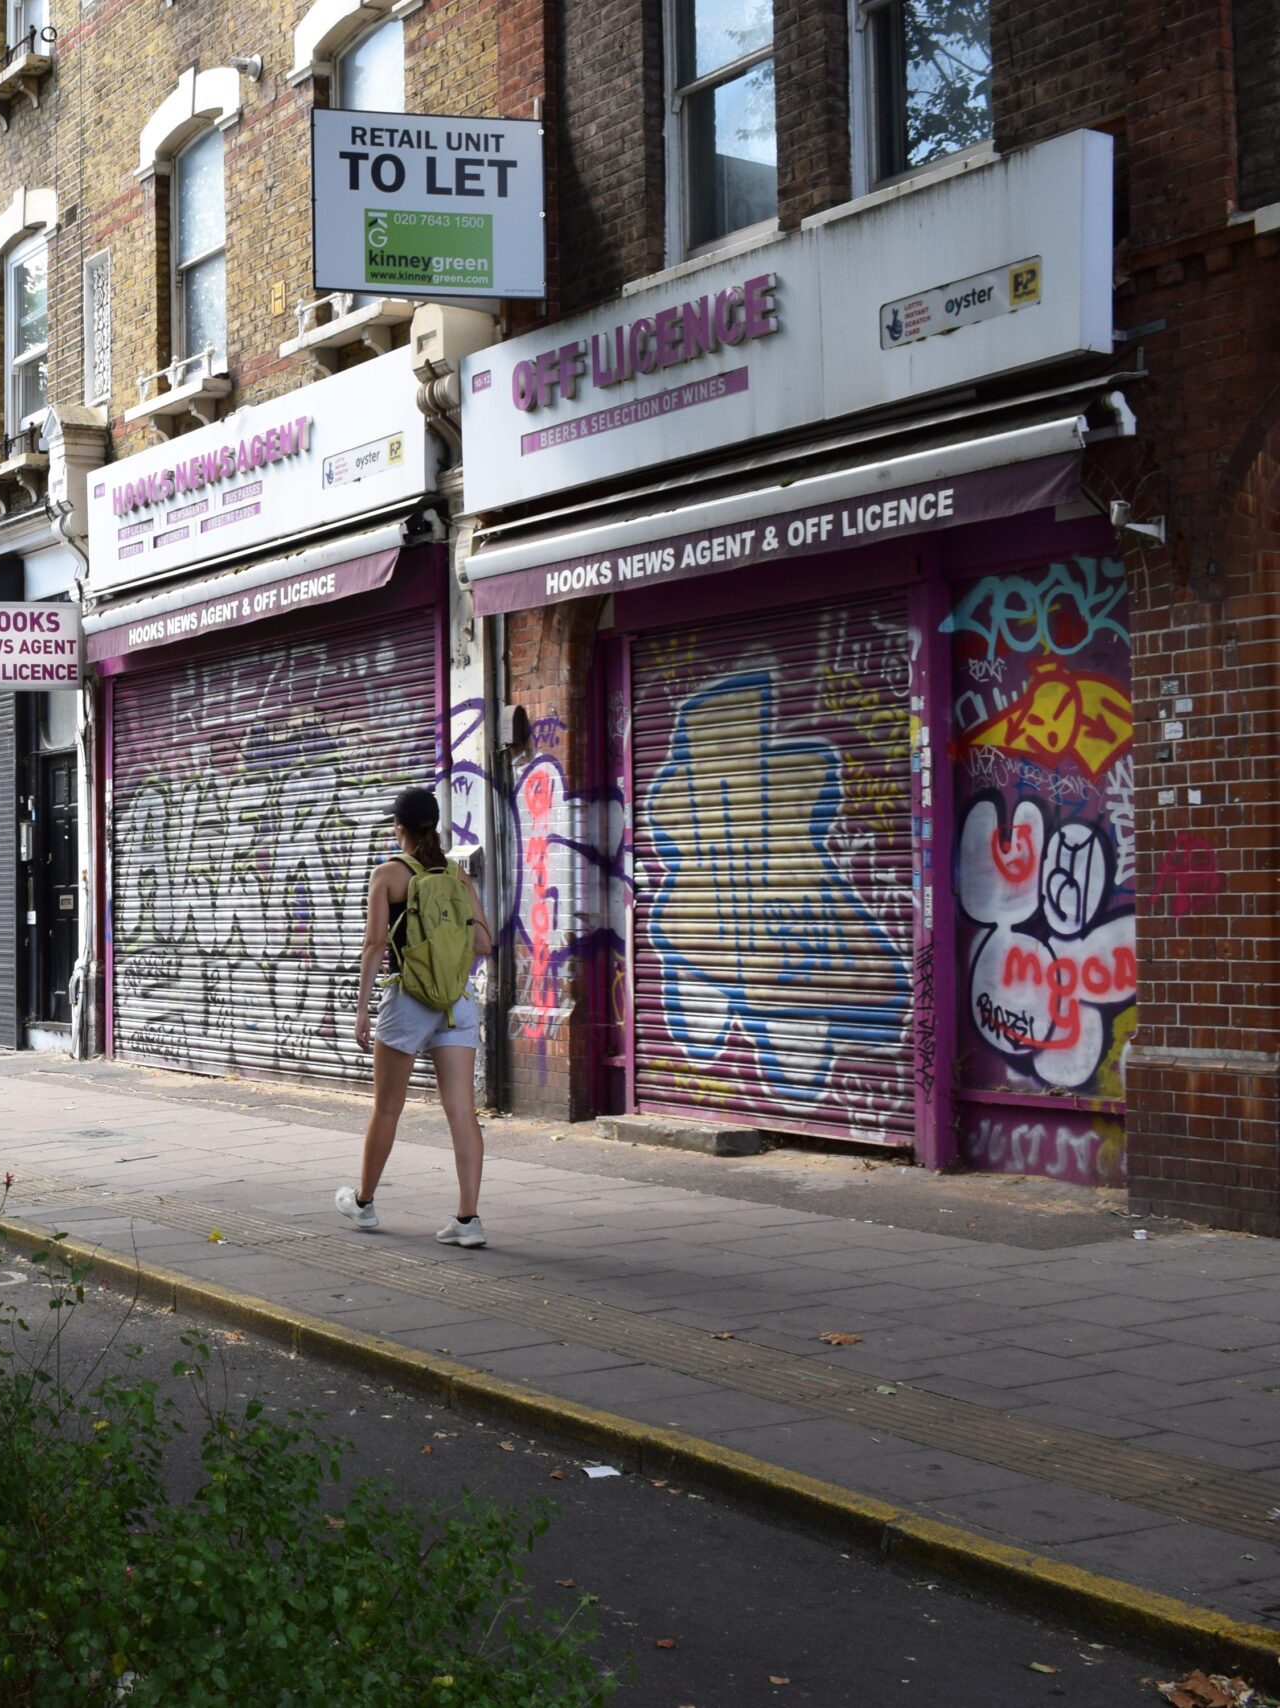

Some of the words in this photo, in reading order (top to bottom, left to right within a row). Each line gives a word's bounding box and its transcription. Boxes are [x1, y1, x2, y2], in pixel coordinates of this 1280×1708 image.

[351, 126, 437, 150] RETAIL
[446, 131, 505, 153] UNIT
[339, 151, 406, 193] TO
[426, 156, 517, 198] LET
[393, 213, 417, 225] 020
[420, 215, 450, 227] 7643
[456, 216, 485, 229] 1500
[369, 250, 488, 272] kinneygreen
[370, 271, 489, 284] www.kinneygreen.com
[944, 285, 995, 316] oyster
[512, 340, 587, 413] OFF
[592, 272, 779, 389] LICENCE
[540, 420, 577, 449] BEERS
[580, 420, 589, 437] &
[591, 394, 660, 432] SELECTION
[662, 392, 680, 413] OF
[683, 377, 727, 405] WINES
[113, 468, 174, 517] HOOKS
[176, 445, 235, 496] NEWS
[236, 415, 313, 475] AGENT
[355, 450, 380, 470] oyster
[238, 481, 261, 499] PASSES
[545, 560, 612, 596] HOOKS
[618, 547, 675, 582] NEWS
[680, 529, 756, 570] AGENT
[761, 525, 780, 552] &
[787, 513, 833, 547] OFF
[842, 488, 955, 537] LICENCE
[128, 620, 165, 646] HOOKS
[166, 611, 198, 637] NEWS
[200, 600, 239, 627] AGENT
[242, 597, 251, 617] &
[254, 589, 277, 612] OFF
[280, 573, 336, 606] LICENCE
[18, 639, 77, 655] AGENT
[1, 663, 78, 681] LICENCE
